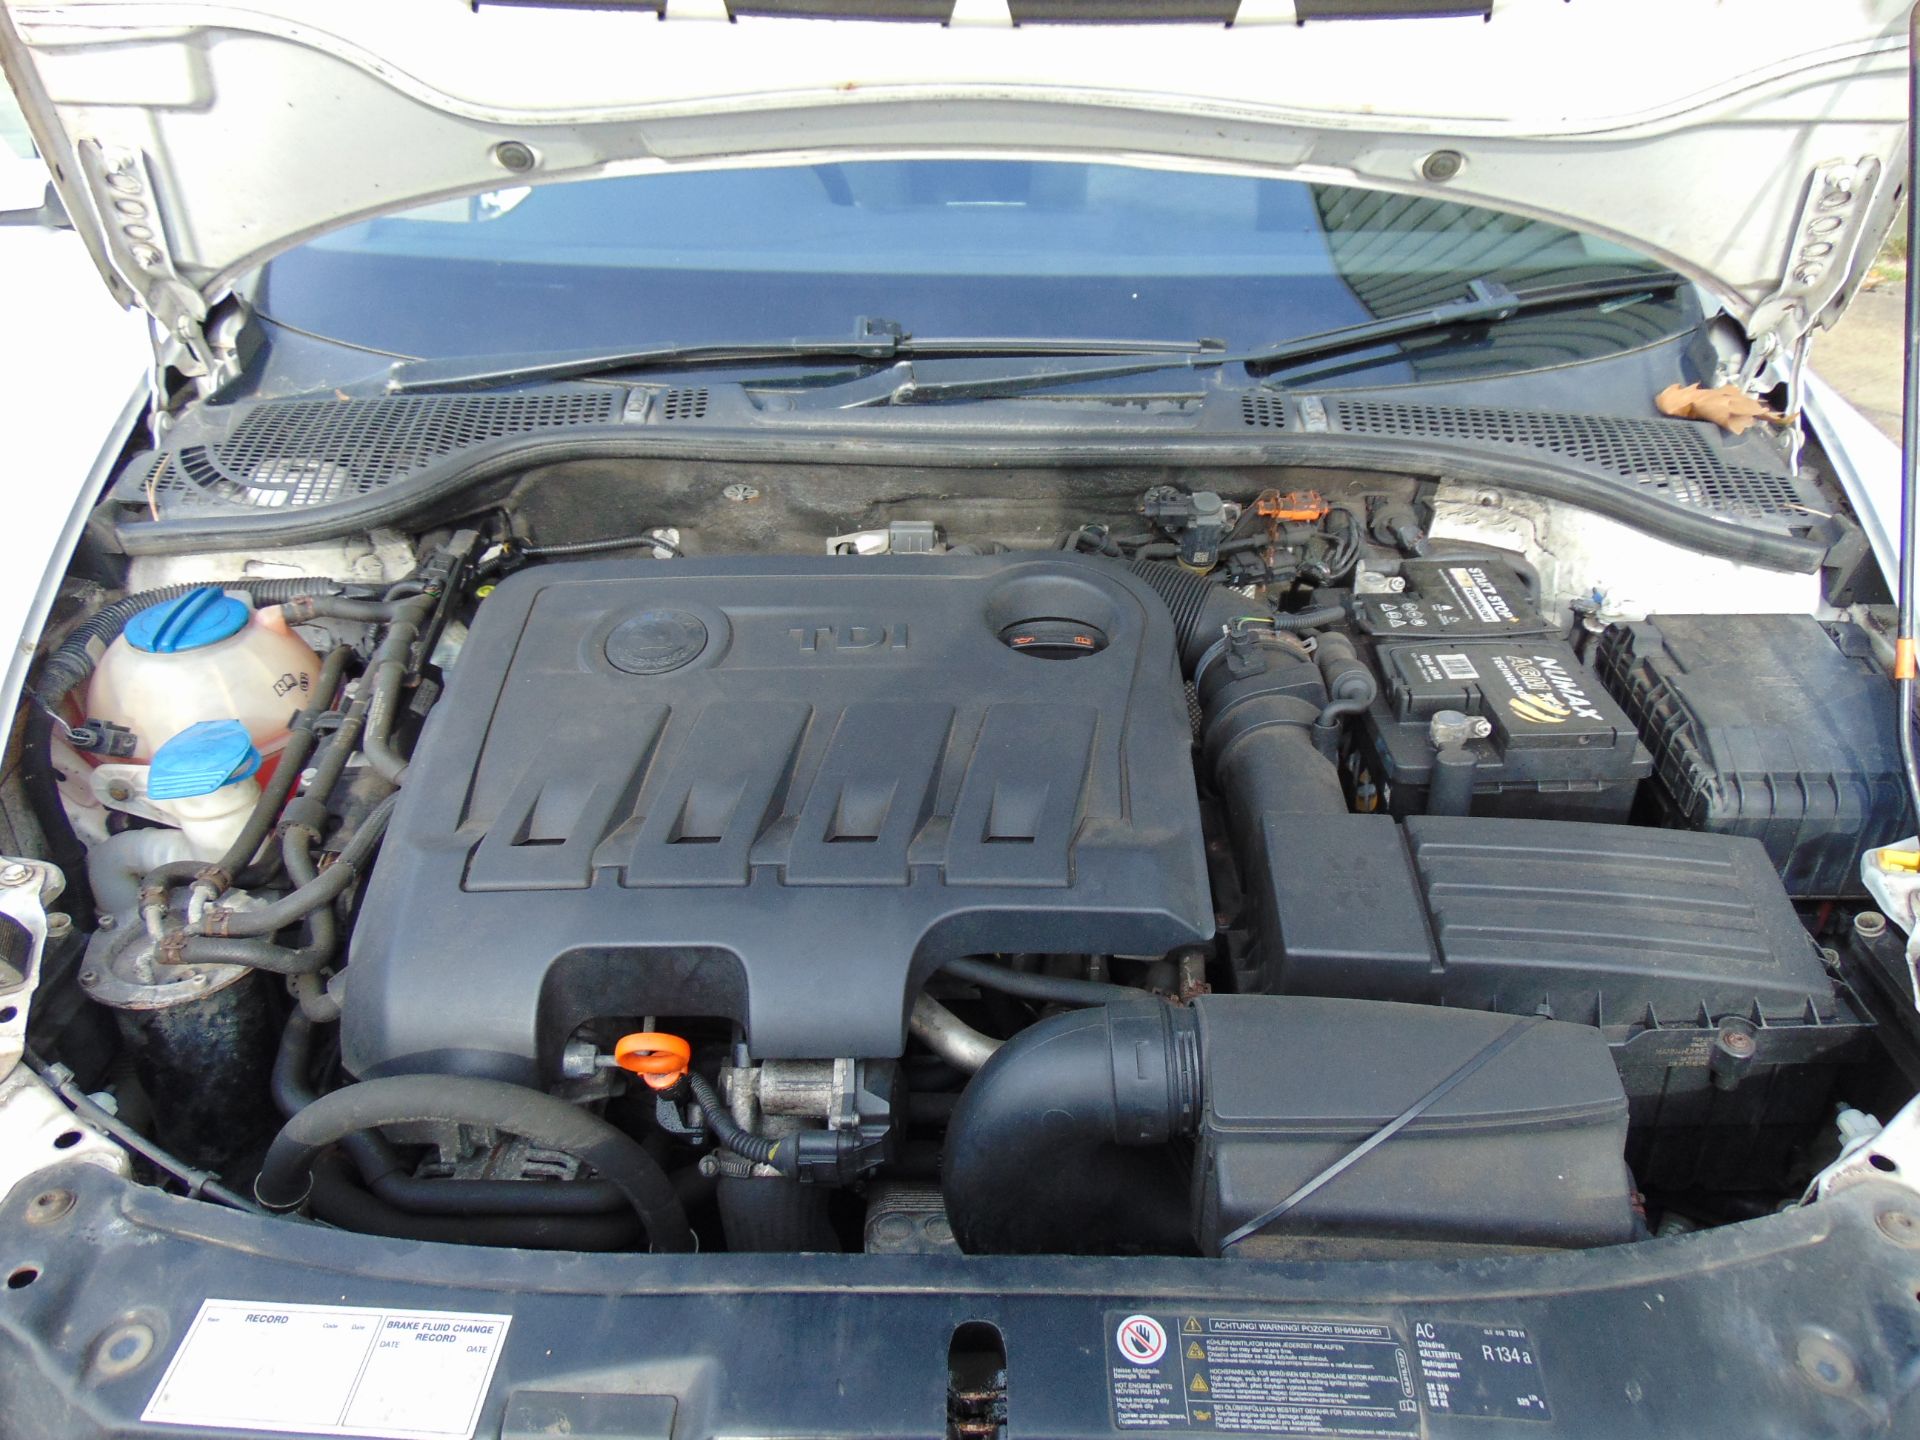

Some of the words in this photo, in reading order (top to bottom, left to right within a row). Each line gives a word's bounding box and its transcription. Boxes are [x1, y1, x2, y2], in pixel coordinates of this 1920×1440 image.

[789, 623, 909, 651] TDI
[1506, 656, 1551, 690] AGM
[1533, 656, 1604, 720] NUMAX
[245, 1314, 289, 1324] RECORD
[386, 1320, 420, 1331] BRAKE
[421, 1323, 450, 1332] FLUID
[452, 1324, 494, 1334] CHANGE
[1214, 1321, 1257, 1330] ACHTUNG!
[1258, 1323, 1300, 1332] WARNING!
[1416, 1323, 1435, 1339] AC
[379, 1341, 400, 1349] DATE
[415, 1333, 457, 1343] RECORD
[466, 1345, 488, 1354] DATE
[1482, 1344, 1495, 1362] R
[1495, 1346, 1521, 1364] 134
[1522, 1352, 1533, 1365] a
